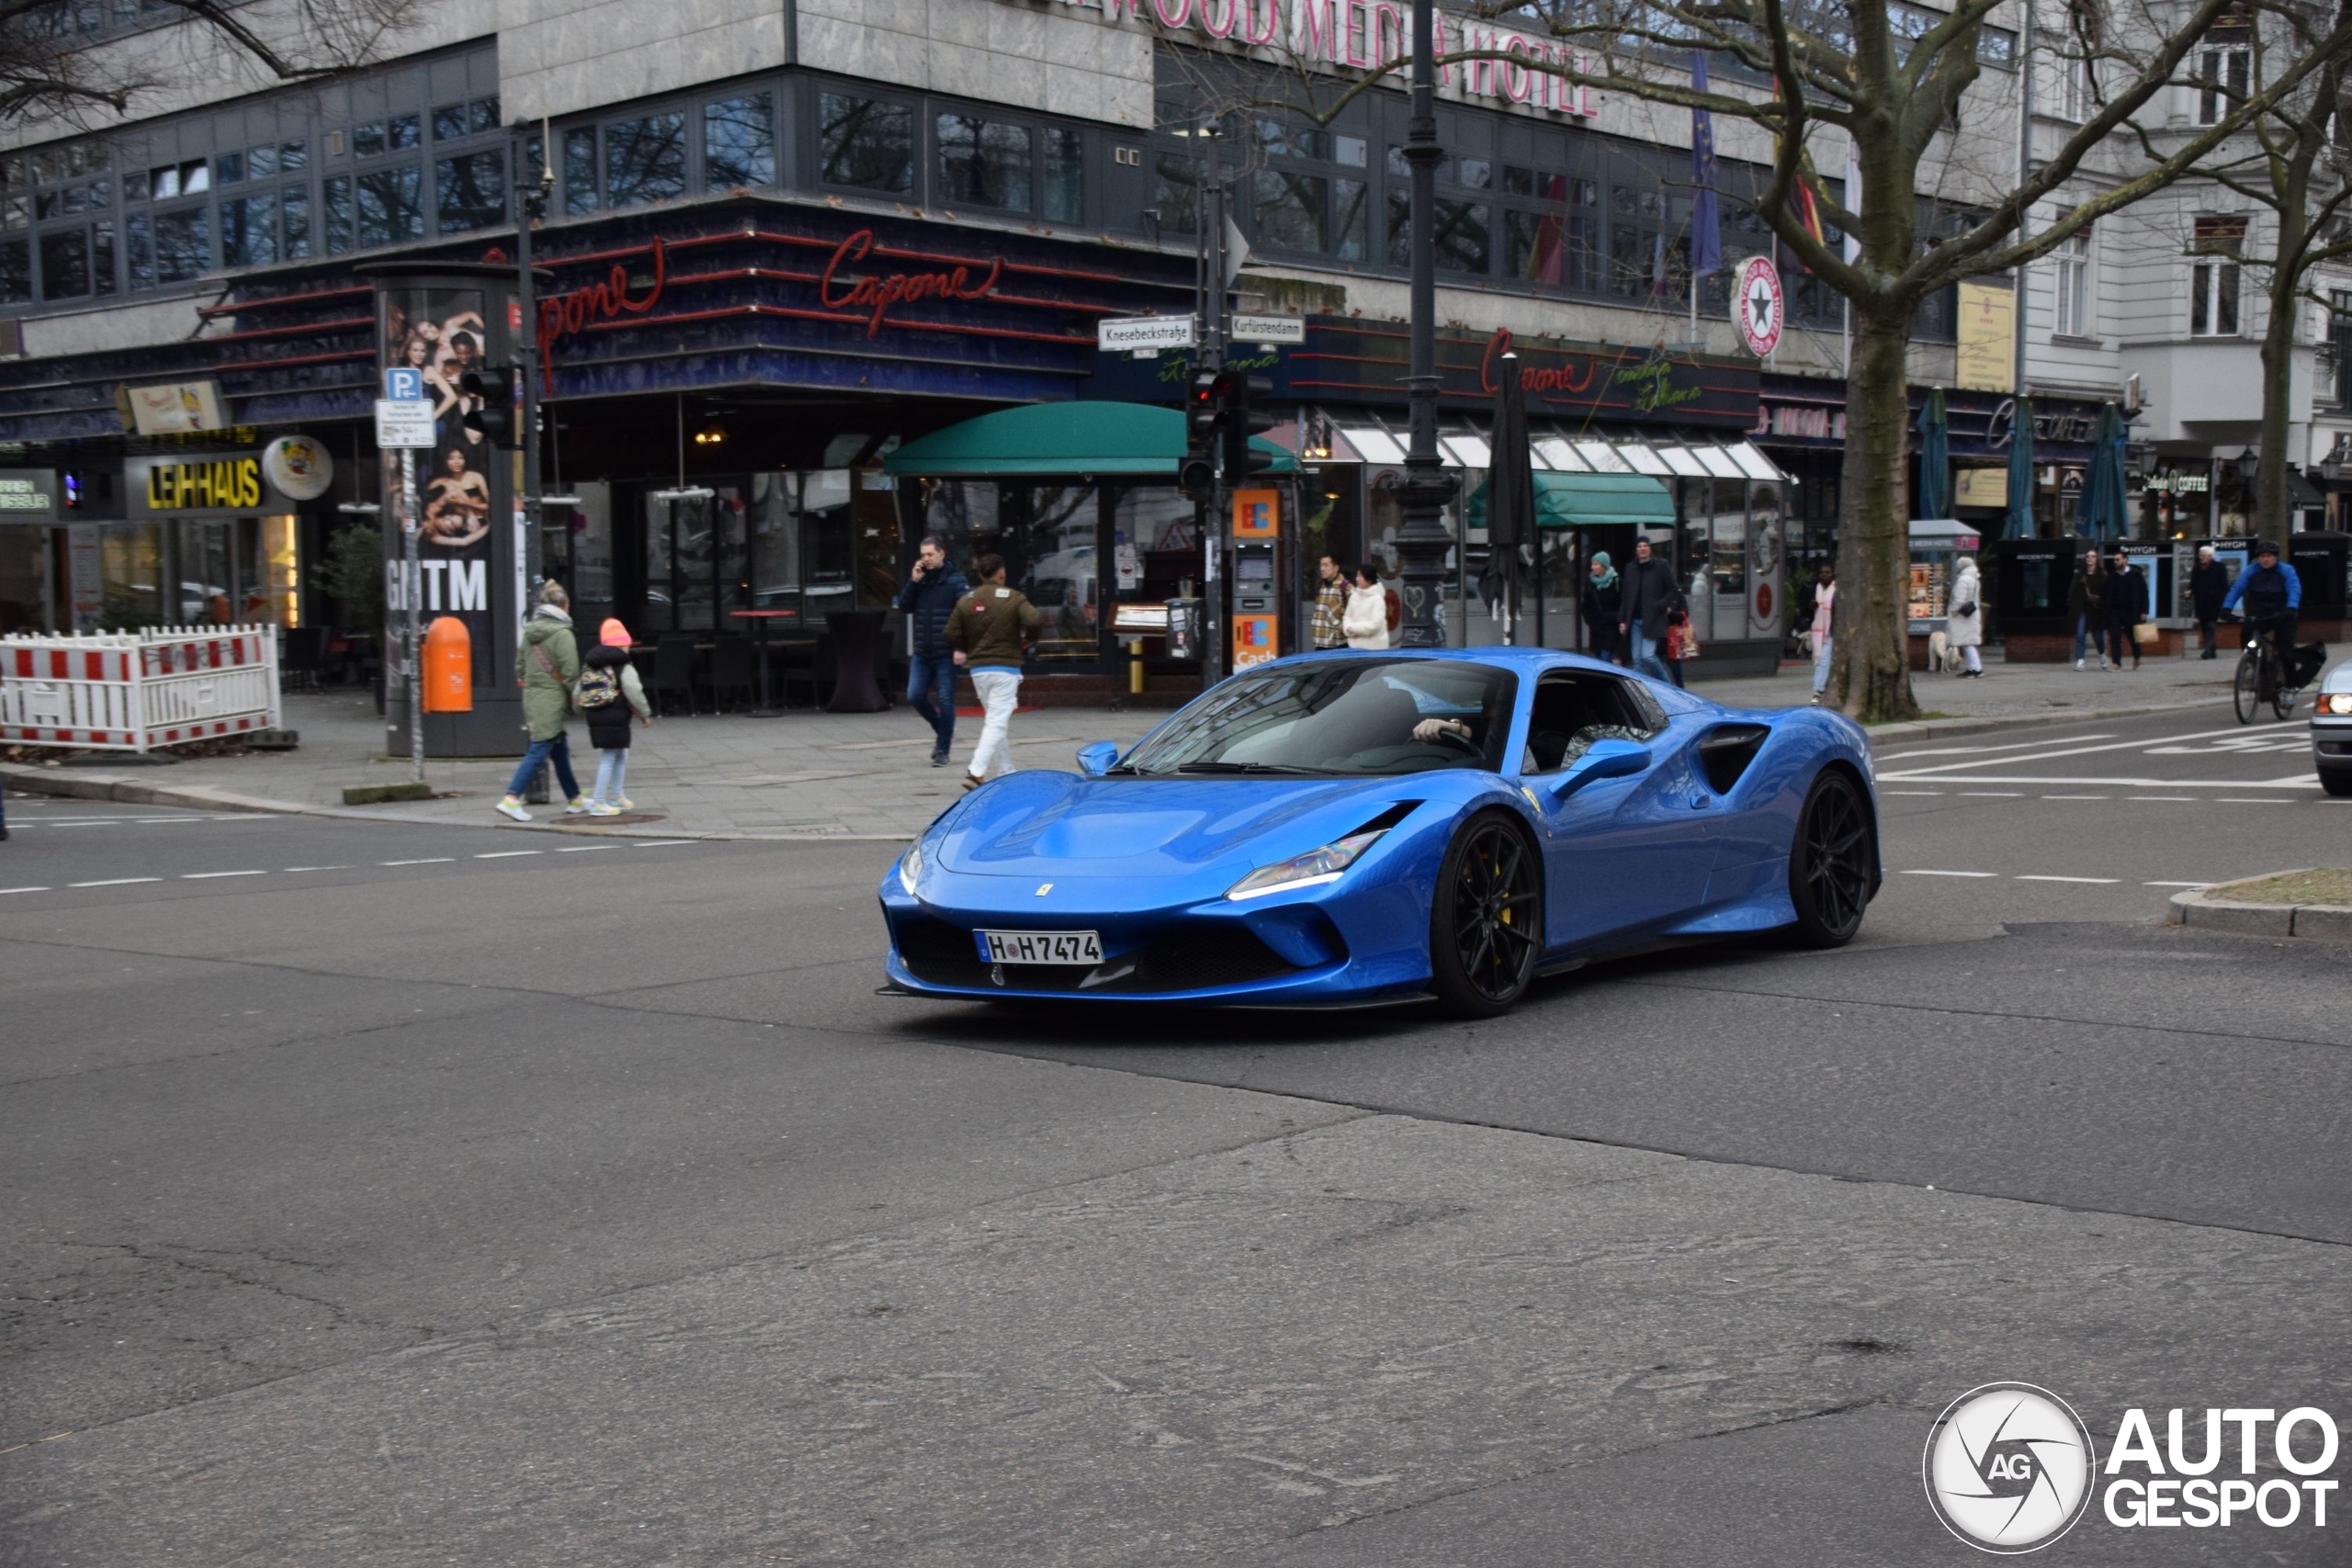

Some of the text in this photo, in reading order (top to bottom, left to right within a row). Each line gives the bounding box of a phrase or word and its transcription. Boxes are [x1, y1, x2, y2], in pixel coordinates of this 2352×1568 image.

[1470, 27, 1599, 118] HOTEL
[821, 229, 1004, 339] Capone
[1106, 325, 1187, 342] Knesebeckstraße
[1234, 320, 1300, 335] Kurfürstendamm
[394, 373, 413, 398] P
[148, 457, 259, 509] LEIHHAUS
[2129, 546, 2157, 555] HYGH
[2220, 540, 2247, 549] HYGH
[1236, 650, 1278, 667] Cash
